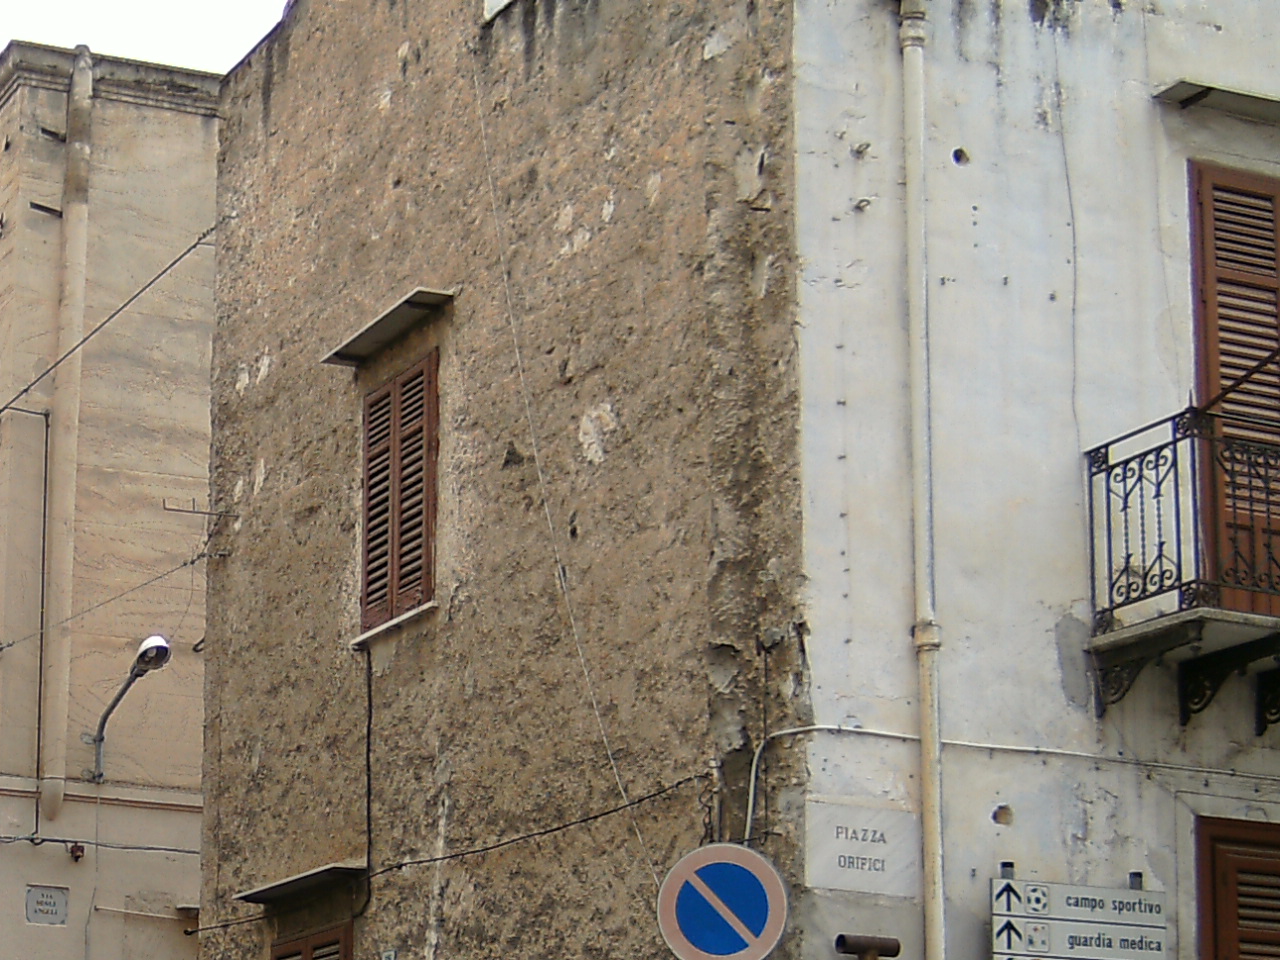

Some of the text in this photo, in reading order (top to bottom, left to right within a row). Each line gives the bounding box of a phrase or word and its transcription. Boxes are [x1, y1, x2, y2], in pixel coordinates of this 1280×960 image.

[835, 825, 888, 844] PIAZZA
[1065, 895, 1162, 915] campo sportivo
[1067, 933, 1162, 952] guardia medica
